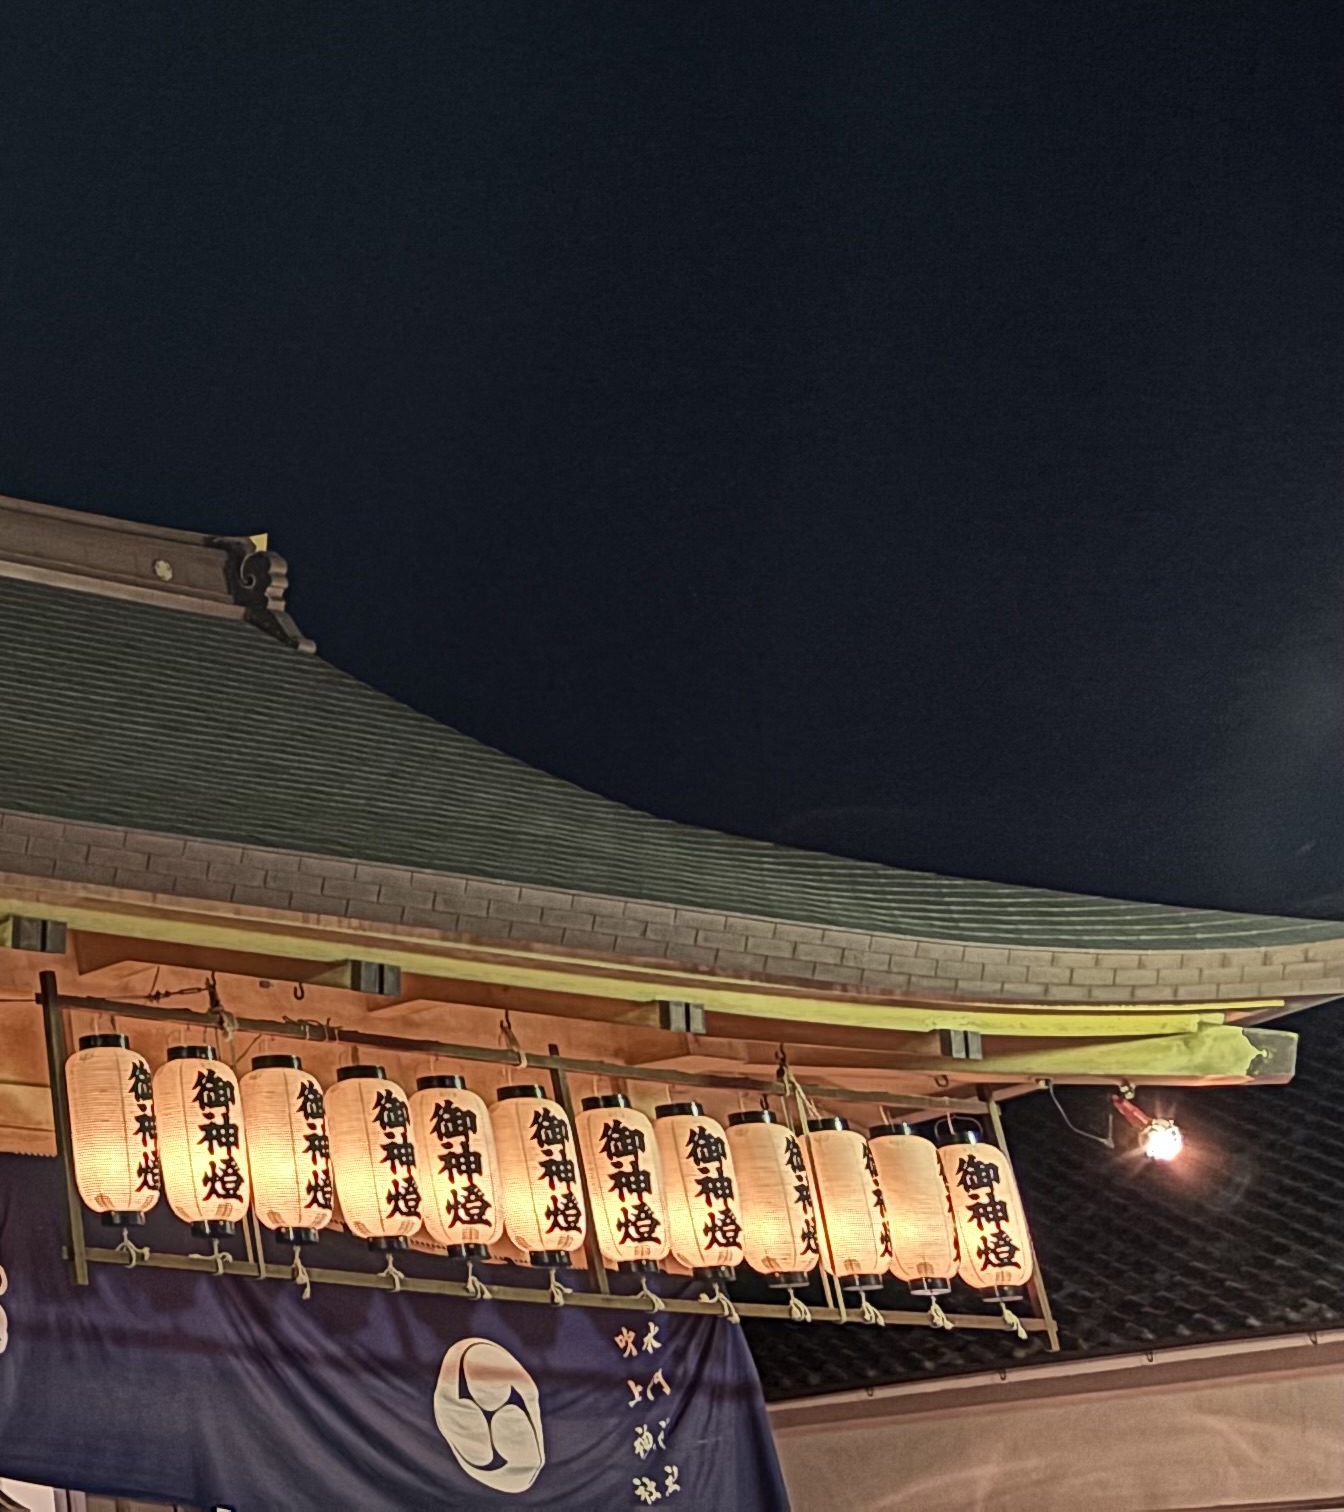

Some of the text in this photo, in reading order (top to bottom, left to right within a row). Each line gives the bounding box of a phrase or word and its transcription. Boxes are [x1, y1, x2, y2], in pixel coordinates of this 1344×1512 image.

[192, 1069, 244, 1203] 御神燈
[372, 1089, 422, 1219] 御神燈
[430, 1099, 492, 1228] 御神燈
[529, 1107, 582, 1234] 御神燈
[599, 1119, 662, 1244] 御神燈
[685, 1126, 742, 1250] 御神燈
[955, 1154, 1021, 1271] 御神燈
